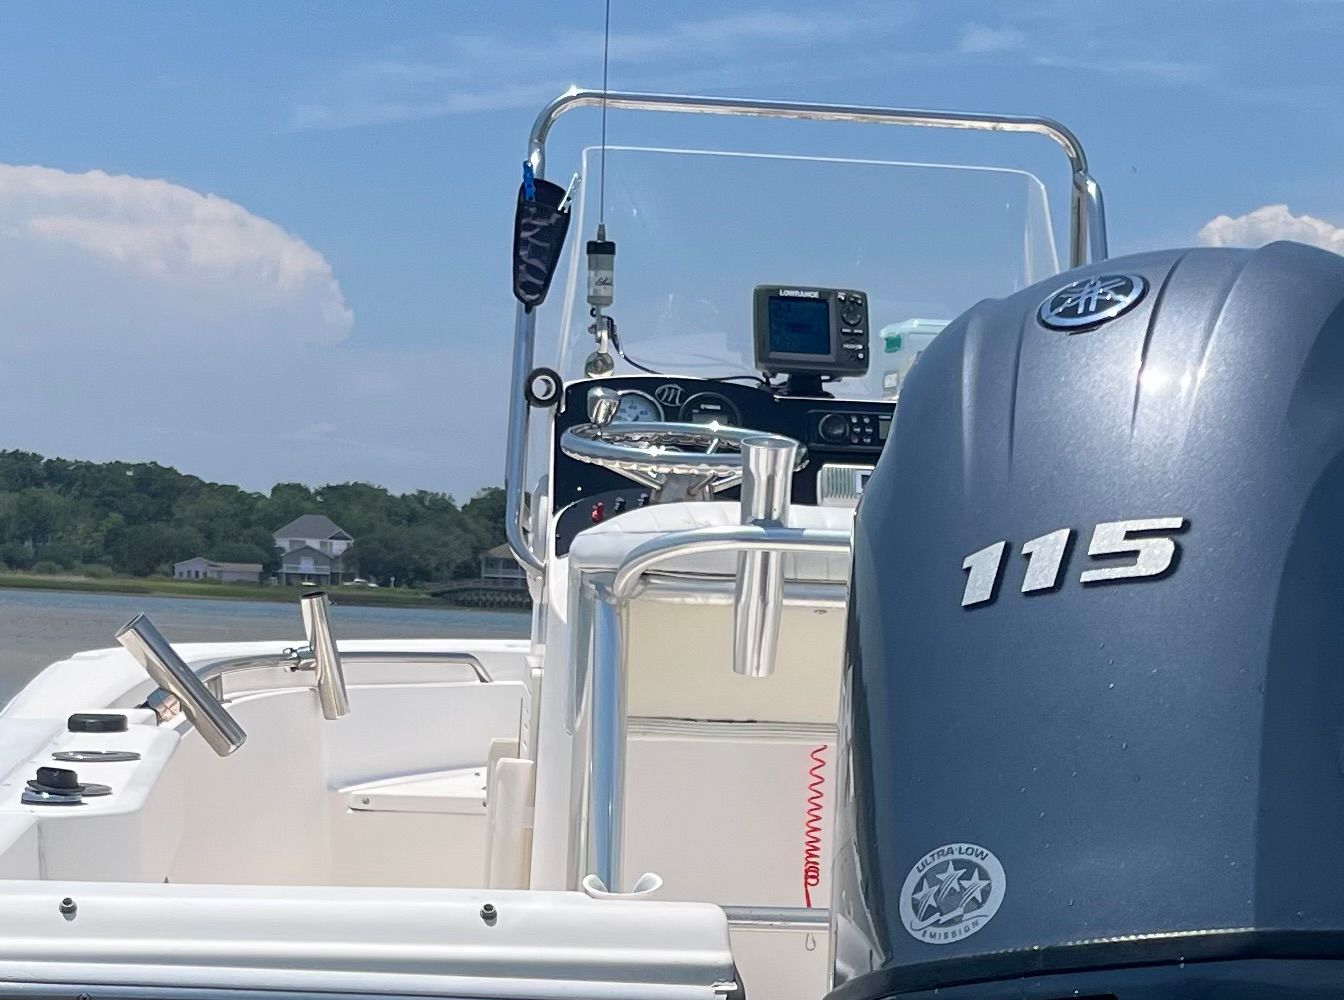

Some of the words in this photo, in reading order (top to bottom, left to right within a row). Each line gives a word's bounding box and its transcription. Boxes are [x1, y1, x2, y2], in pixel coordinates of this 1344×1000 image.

[961, 516, 1185, 607] 115
[916, 846, 954, 873] ULTRA
[958, 846, 989, 861] LOW
[921, 919, 980, 940] EMISSION
